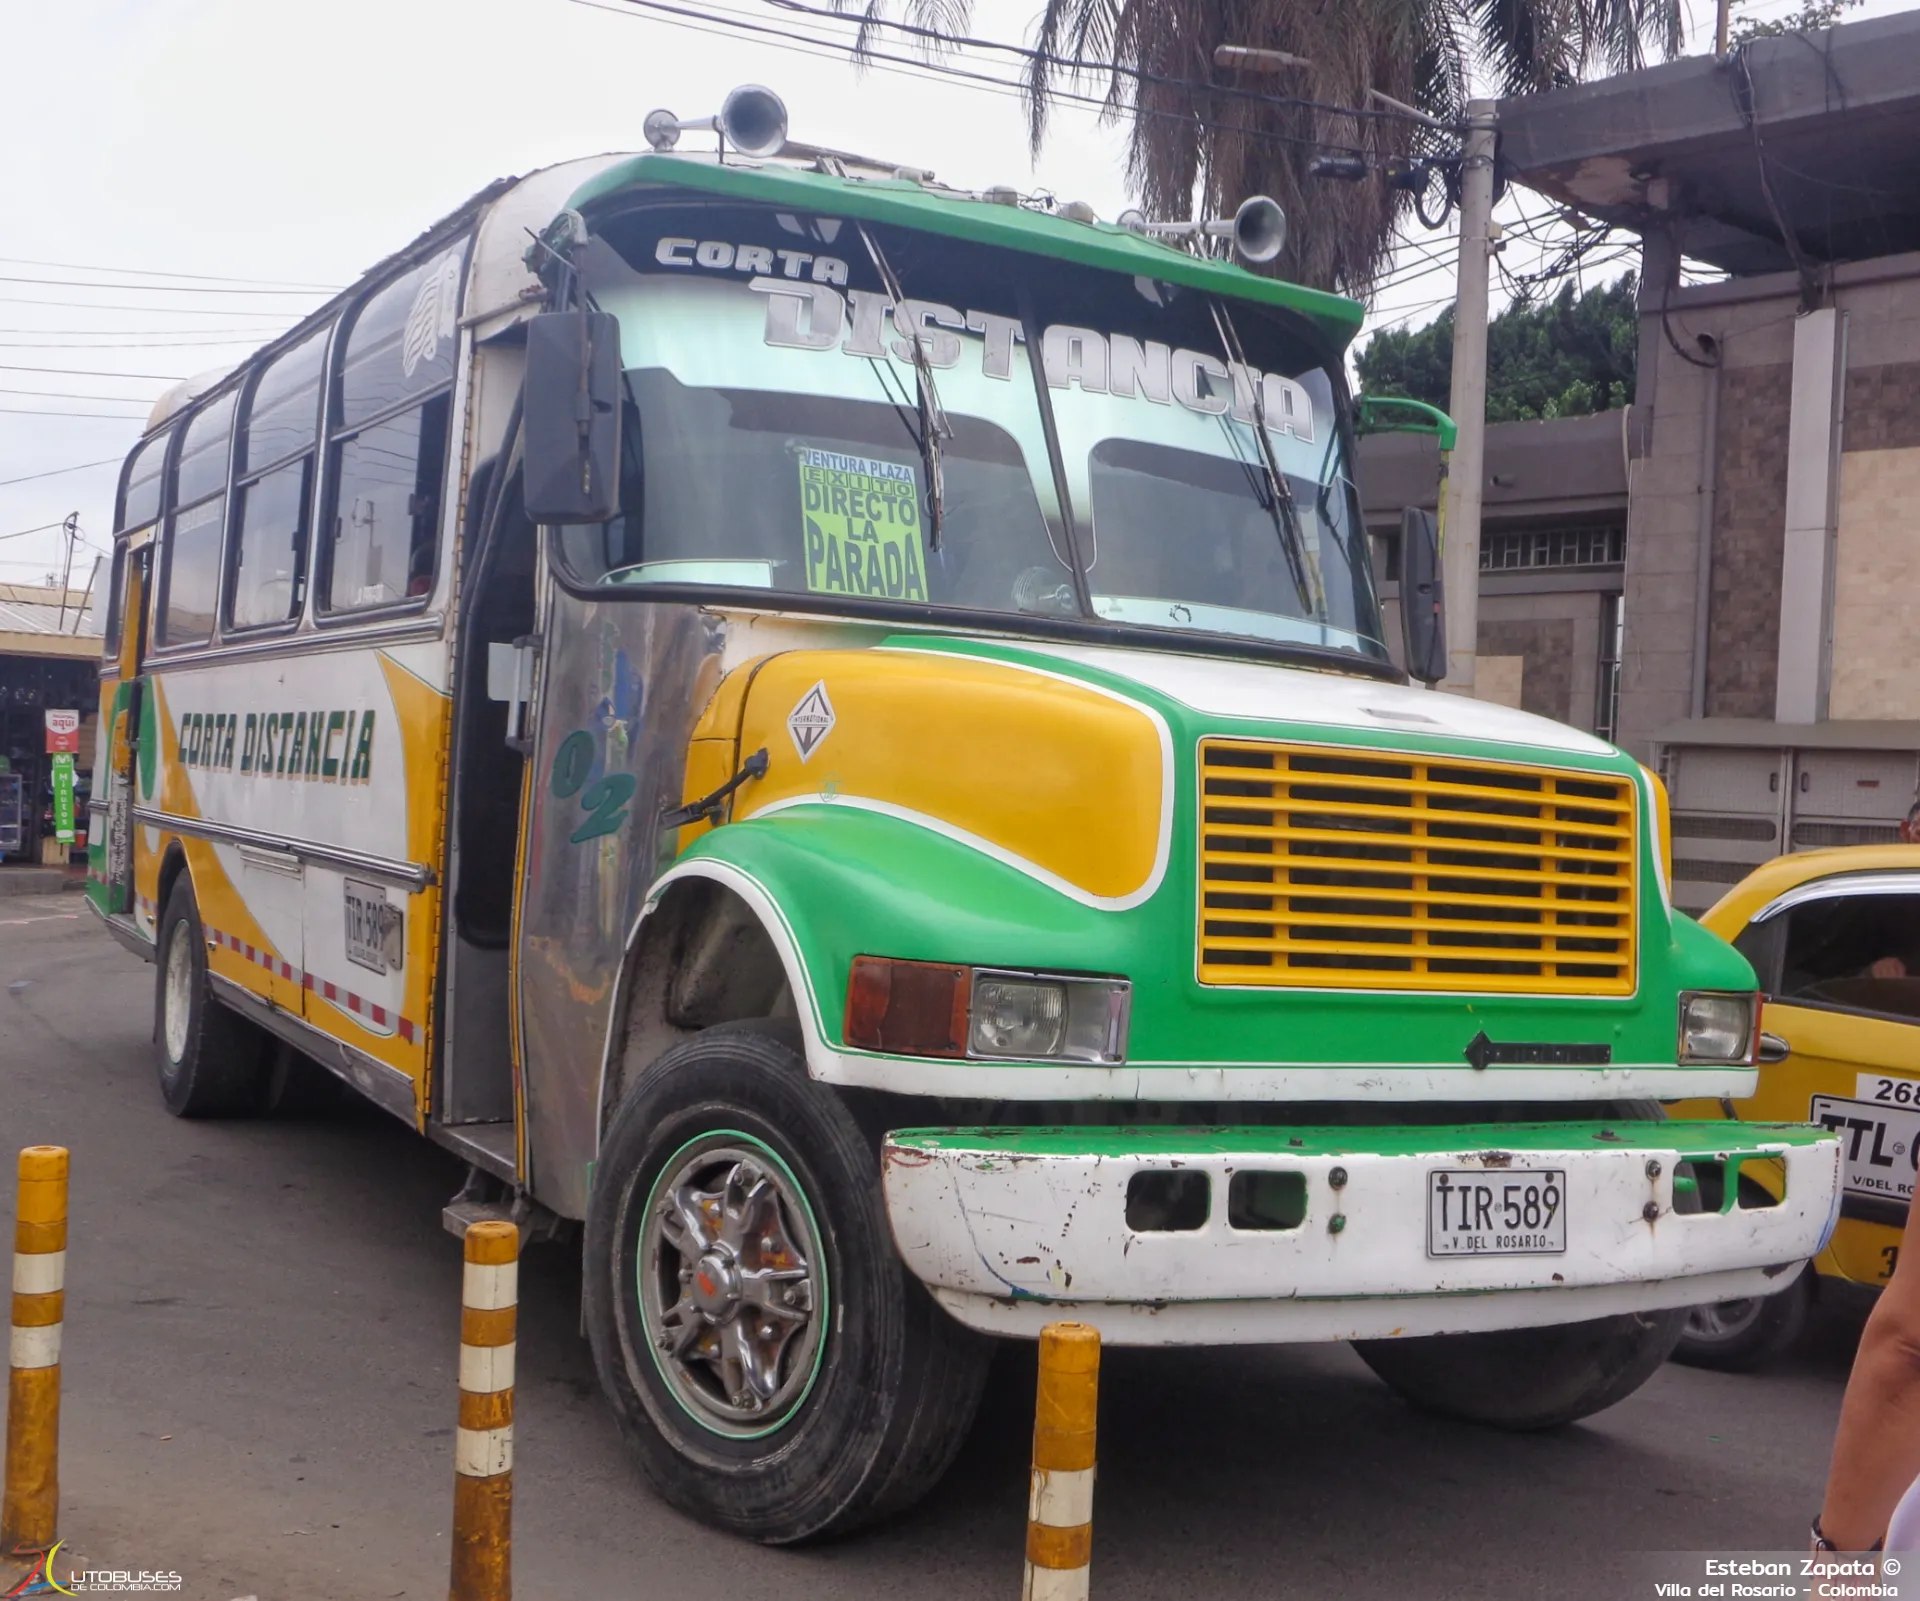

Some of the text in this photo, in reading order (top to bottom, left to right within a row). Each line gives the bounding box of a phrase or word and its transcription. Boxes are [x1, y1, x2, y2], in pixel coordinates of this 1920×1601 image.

[655, 237, 848, 285] CORTA
[748, 276, 1314, 443] DISTANCIA
[804, 451, 912, 482] VENTURA PLAZA
[805, 467, 913, 497] EXITO
[804, 483, 916, 527] DIRECTO
[847, 517, 879, 543] LA
[806, 514, 925, 600] PARADA
[178, 709, 376, 786] CORTA DISTANCIA
[552, 731, 636, 843] 02
[1436, 1185, 1560, 1231] TIR 589
[1496, 1234, 1546, 1249] ROSARIO
